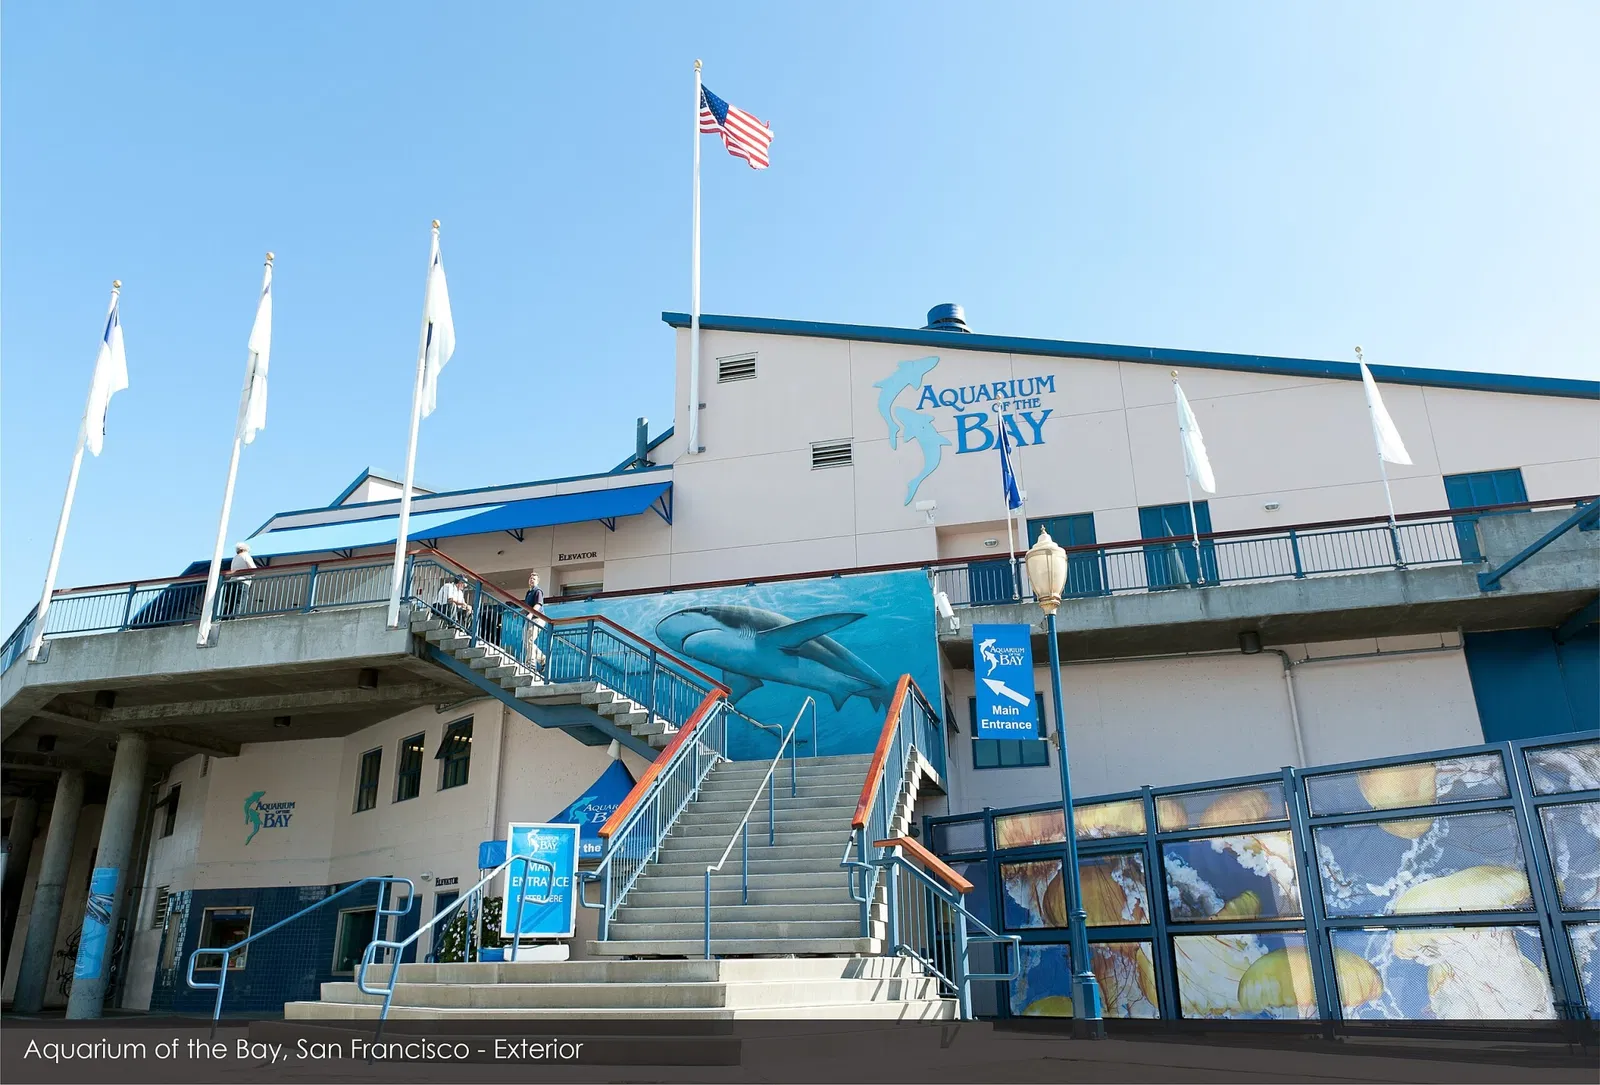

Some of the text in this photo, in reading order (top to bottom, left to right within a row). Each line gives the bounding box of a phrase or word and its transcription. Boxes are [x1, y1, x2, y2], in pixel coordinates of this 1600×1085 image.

[916, 375, 1056, 412] AQUARIUM
[992, 397, 1041, 413] OF THE
[953, 409, 1054, 454] BAY
[558, 551, 597, 561] ELEVATOR
[1000, 654, 1024, 666] BAY
[992, 705, 1020, 715] Main
[981, 719, 1032, 730] Entrance
[256, 801, 296, 813] AQUARIUM
[583, 804, 619, 812] AQUAR
[263, 813, 293, 828] BAY
[540, 840, 558, 850] BAY
[583, 843, 602, 853] the
